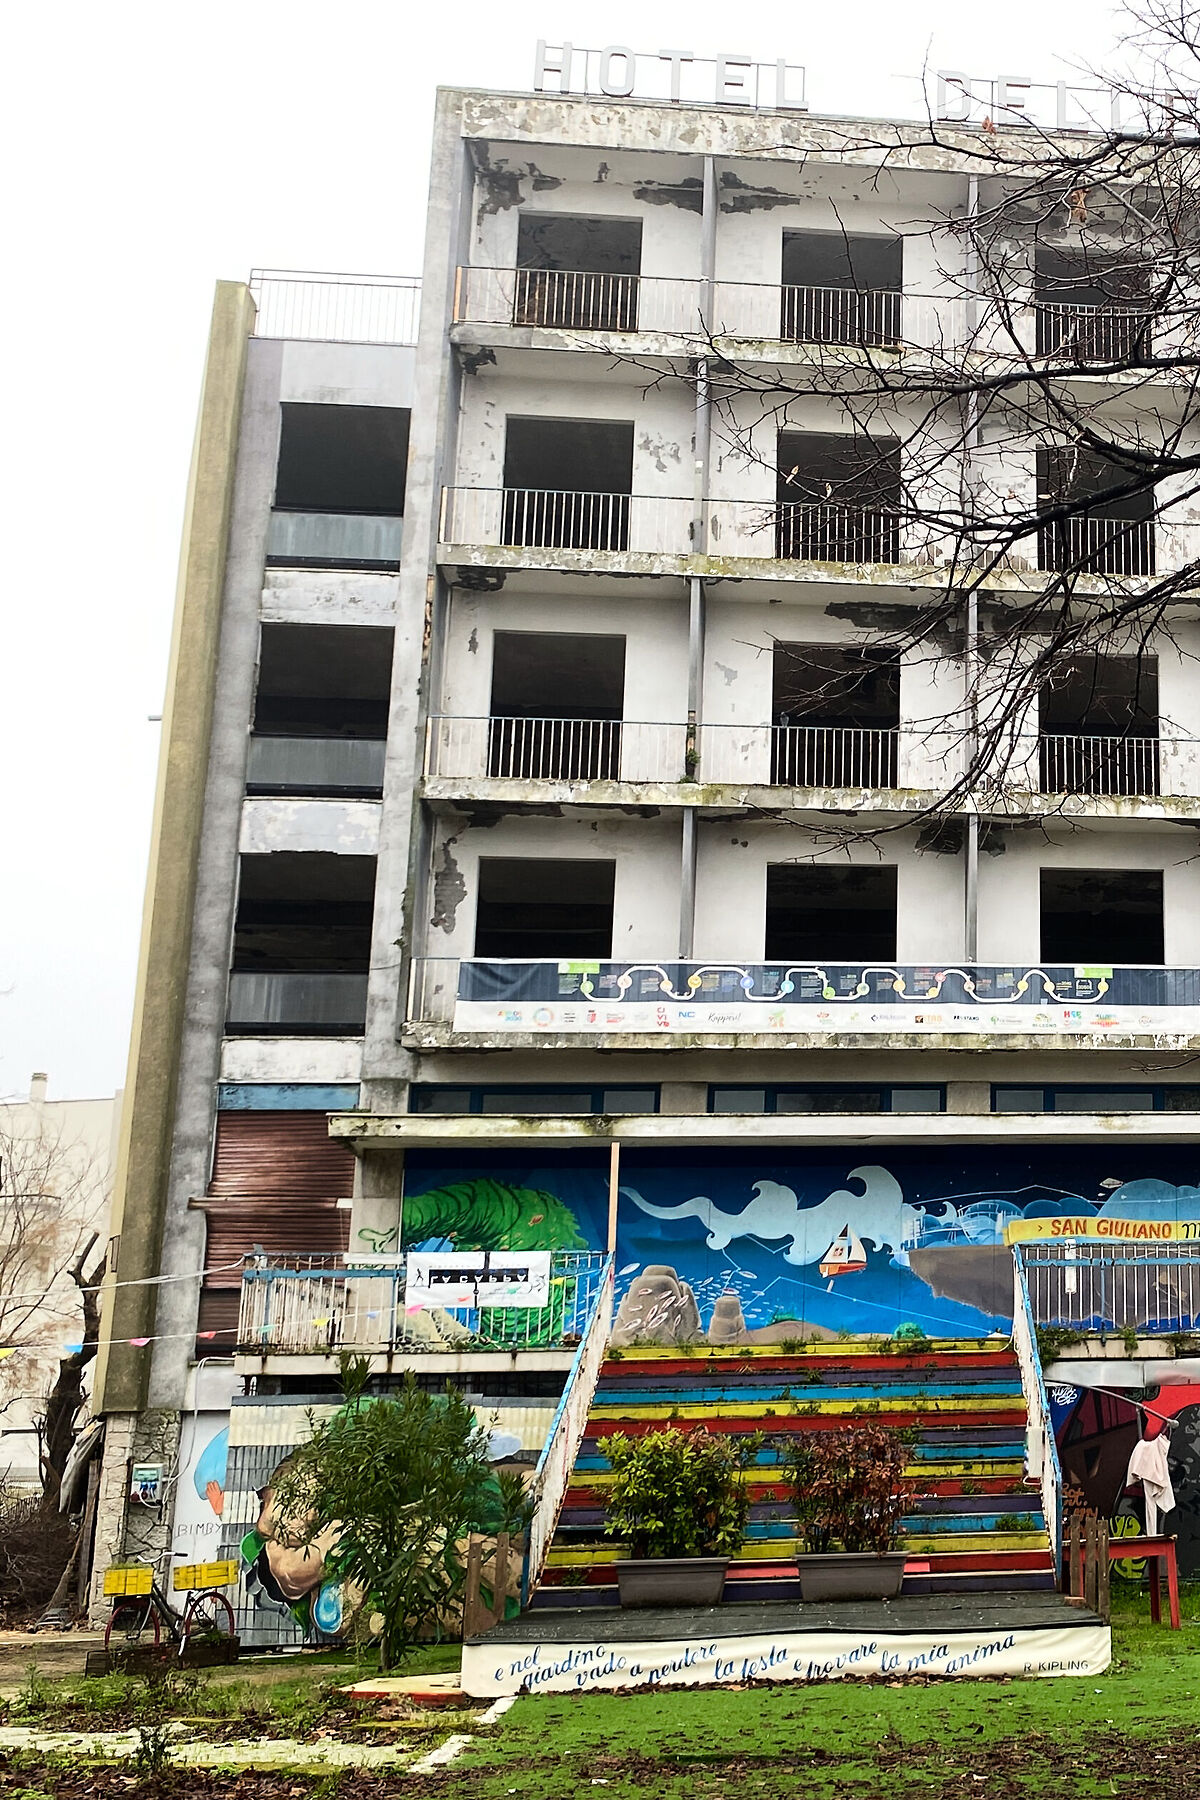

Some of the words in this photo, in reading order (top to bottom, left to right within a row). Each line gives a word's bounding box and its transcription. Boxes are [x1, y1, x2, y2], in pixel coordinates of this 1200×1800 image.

[533, 39, 809, 112] HOTEL
[1051, 1219, 1087, 1236] SAN
[1096, 1219, 1172, 1239] GIULIANO
[177, 1523, 223, 1537] BIMBY
[494, 1667, 504, 1682] e
[509, 1645, 541, 1676] nel
[522, 1645, 606, 1692] giardino
[576, 1652, 627, 1686] vado
[630, 1663, 643, 1677] a
[714, 1658, 735, 1680] la
[741, 1645, 789, 1680] testa
[793, 1658, 803, 1672] e
[806, 1641, 878, 1678] trovare
[880, 1651, 901, 1673] la
[907, 1643, 950, 1672] mia
[945, 1635, 1016, 1674] anima
[1038, 1660, 1089, 1671] KIPLING
